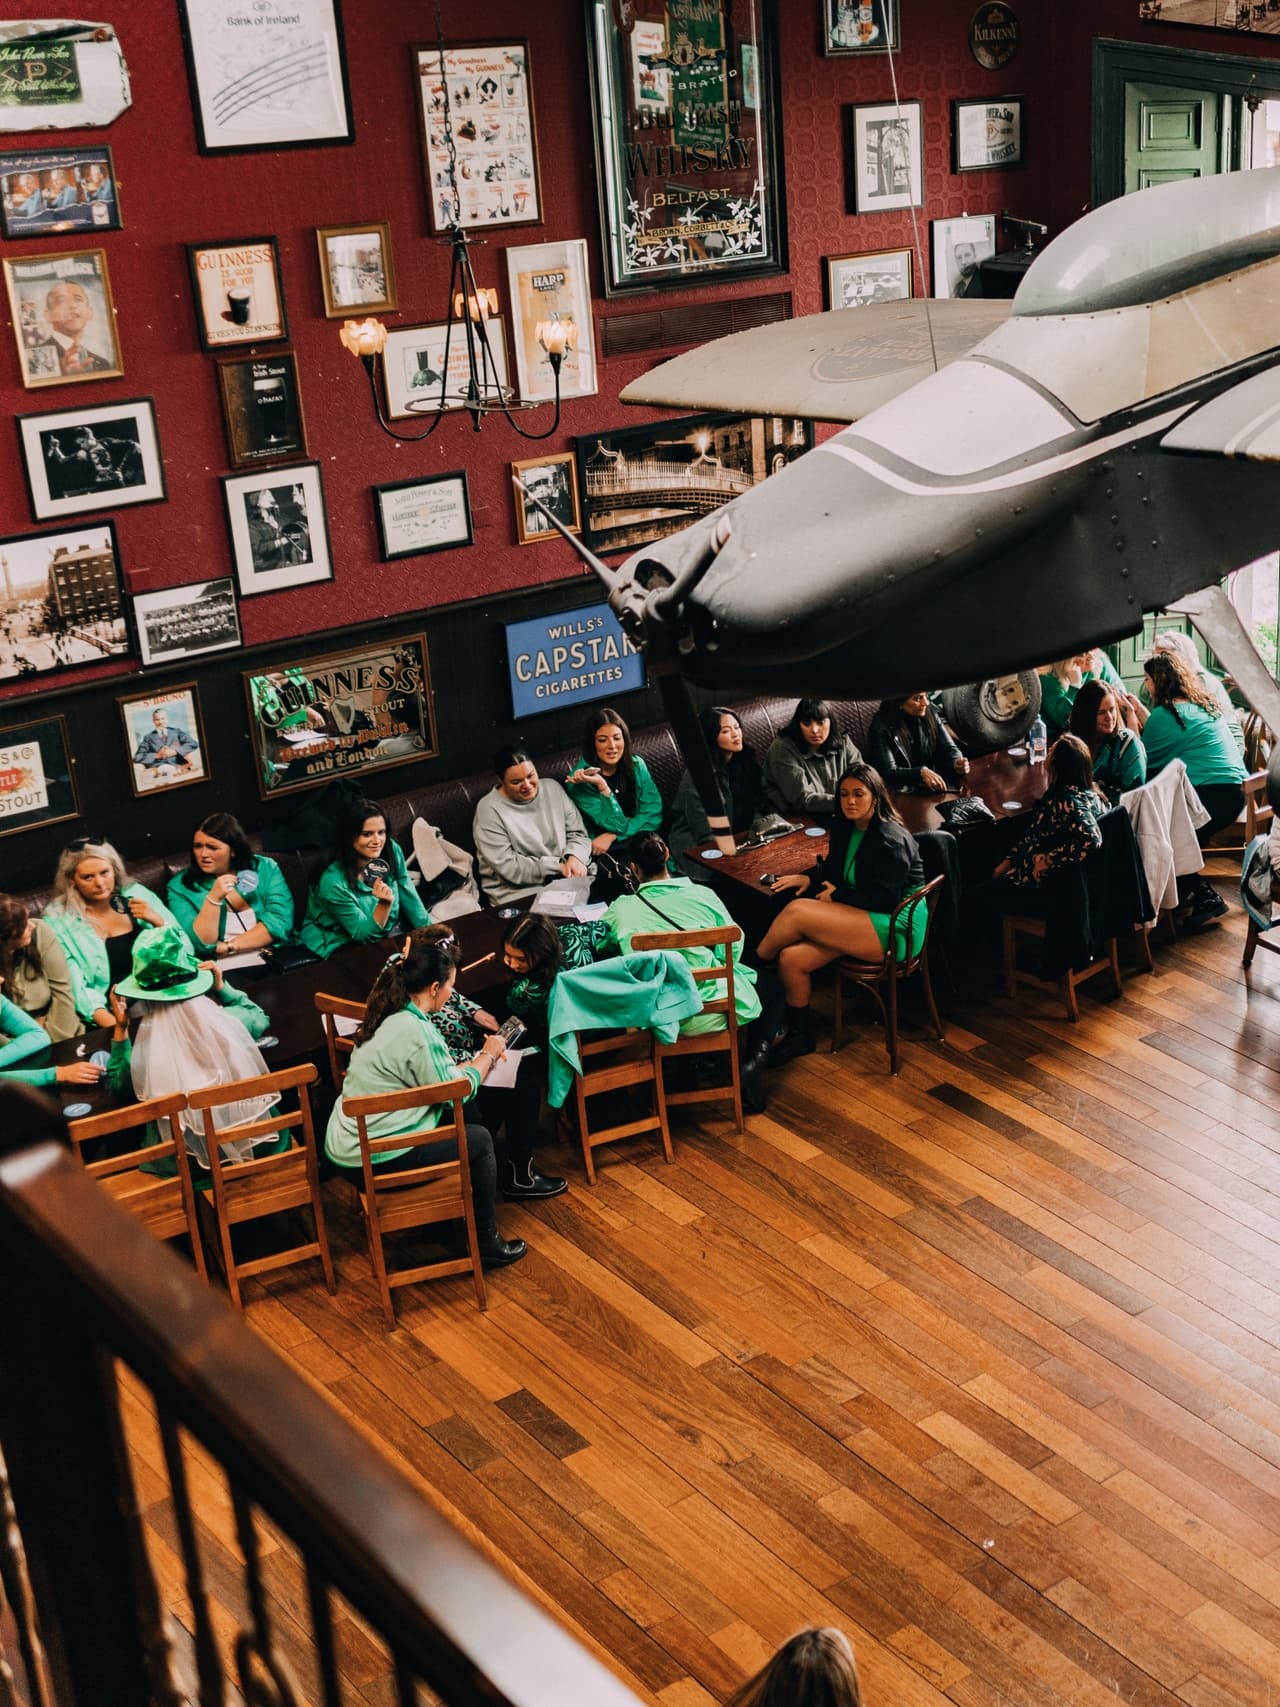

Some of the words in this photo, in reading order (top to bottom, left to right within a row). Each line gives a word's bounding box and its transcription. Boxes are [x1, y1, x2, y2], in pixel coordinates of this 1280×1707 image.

[226, 16, 252, 26] Bank
[254, 16, 264, 25] of
[266, 15, 300, 25] Ireland
[974, 22, 1018, 41] KILKENNY
[24, 62, 48, 80] P
[475, 63, 505, 73] GUINNESS
[622, 135, 755, 179] WHISKY
[196, 248, 273, 271] GUINNESS
[532, 274, 564, 287] HARP
[548, 617, 604, 640] WILLS'S
[515, 631, 638, 682] CAPSTAN
[535, 666, 623, 698] CIGARETTES
[260, 664, 419, 728] GUINNESS
[364, 698, 406, 717] STOUT
[306, 757, 334, 775] and
[335, 745, 390, 767] London
[0, 791, 42, 813] STOUT
